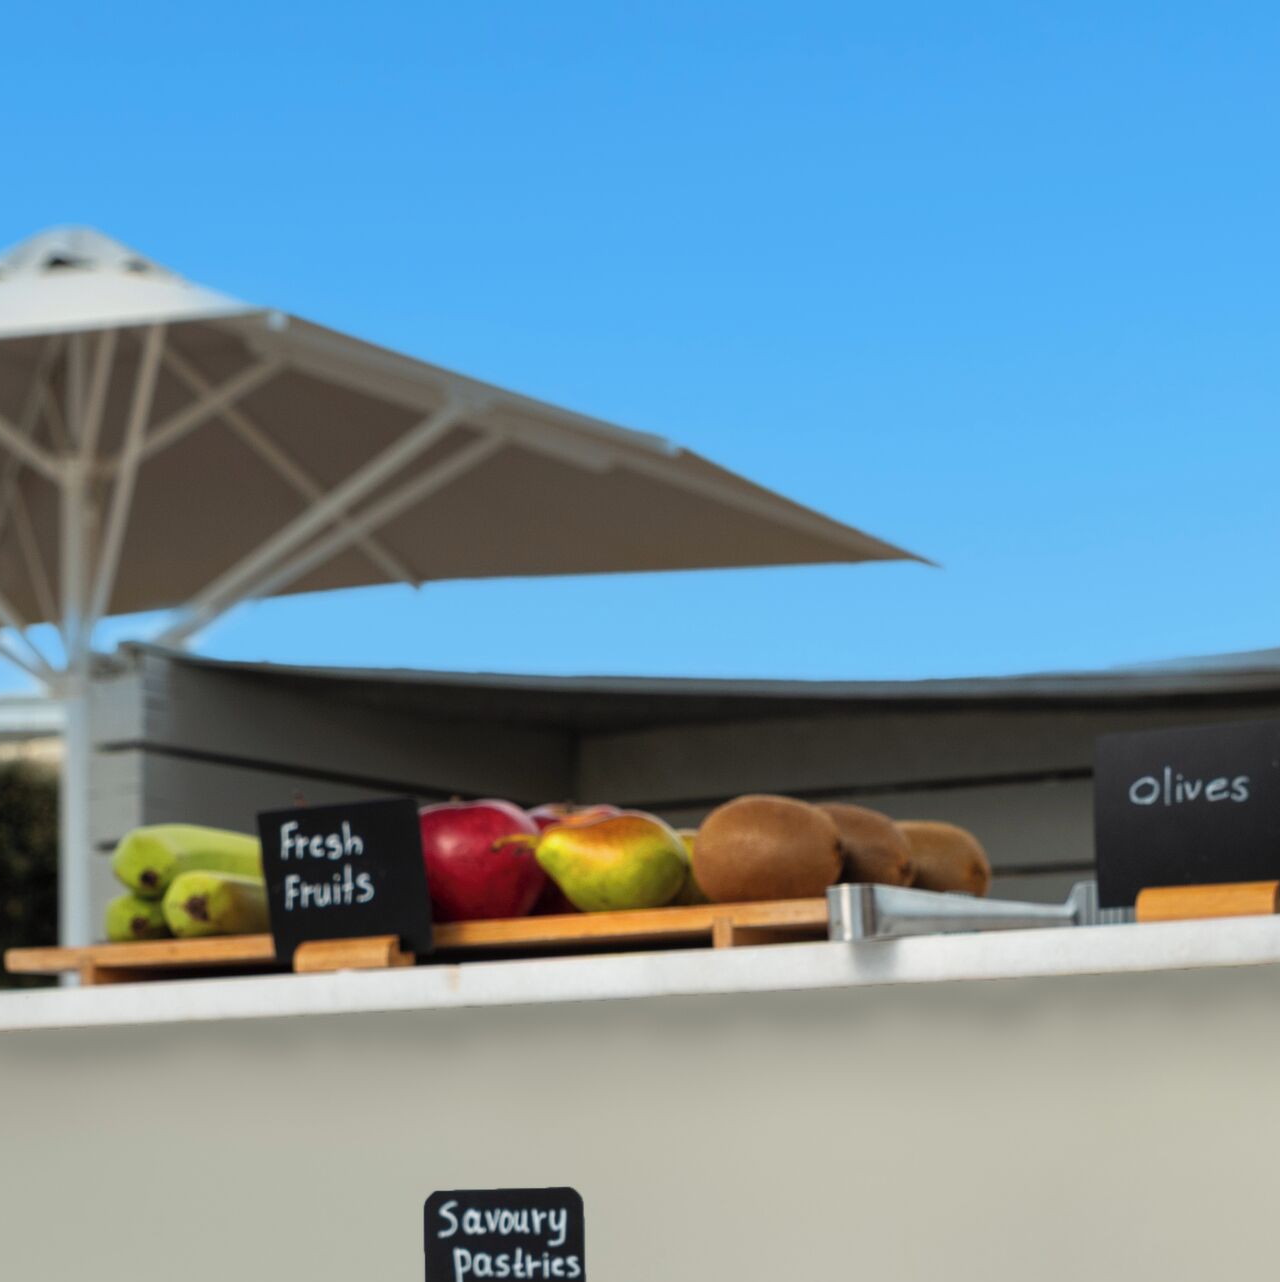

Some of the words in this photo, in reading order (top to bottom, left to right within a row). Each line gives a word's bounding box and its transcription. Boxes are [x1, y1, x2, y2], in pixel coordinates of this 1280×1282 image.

[280, 820, 364, 861] Fresh
[284, 863, 375, 911] Fruits
[437, 1200, 567, 1247] Savoury
